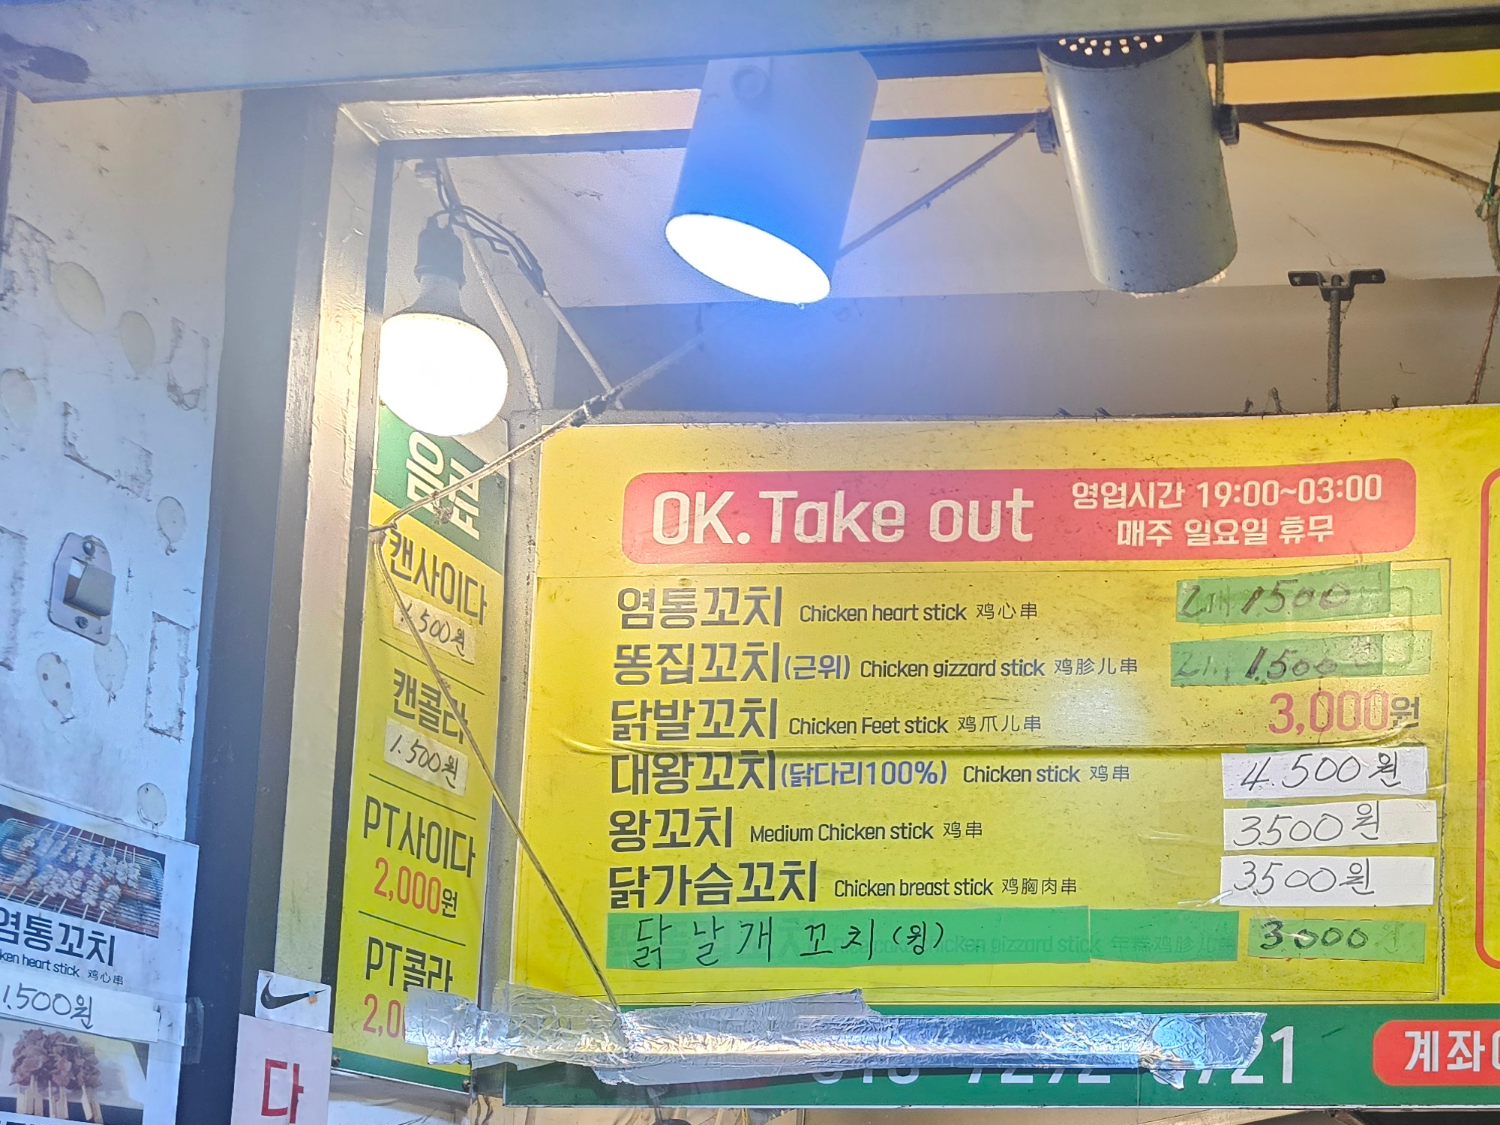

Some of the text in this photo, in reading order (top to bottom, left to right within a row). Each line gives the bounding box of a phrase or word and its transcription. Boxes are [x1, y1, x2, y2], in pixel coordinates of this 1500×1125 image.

[928, 488, 1034, 544] out
[1071, 473, 1383, 510] 영업시간 19:00~03:00
[1117, 515, 1334, 546] 매주 일요일 휴무
[388, 527, 487, 625] 캔사이다
[617, 586, 1038, 630] 염통꼬치 Chicken heart stick 鸡心串
[860, 660, 928, 680] Chicken
[933, 658, 997, 680] gizzard
[1000, 658, 1045, 677] stick
[393, 667, 468, 745] 캔콜라
[610, 698, 777, 742] 닭발꼬치
[789, 716, 857, 735] Chicken
[861, 716, 901, 733] Feet
[904, 715, 949, 733] stick
[1268, 689, 1420, 736] 3,000원
[963, 766, 1032, 784] Chicken
[1036, 764, 1080, 783] stick
[1089, 765, 1131, 782] 鸡串
[363, 794, 476, 878] PT사이다
[608, 806, 983, 854] 왕꼬치 Medium Chicken stick 鸡串
[374, 857, 458, 919] 2,000원
[608, 859, 817, 910] 닭가슴꼬치
[834, 878, 896, 898] Chicken
[900, 877, 950, 897] breast
[953, 877, 993, 896] stick
[1001, 877, 1078, 896] 鸡胸肉串
[22, 954, 51, 973] heart
[53, 963, 80, 978] stick
[366, 936, 454, 993] PT콜라
